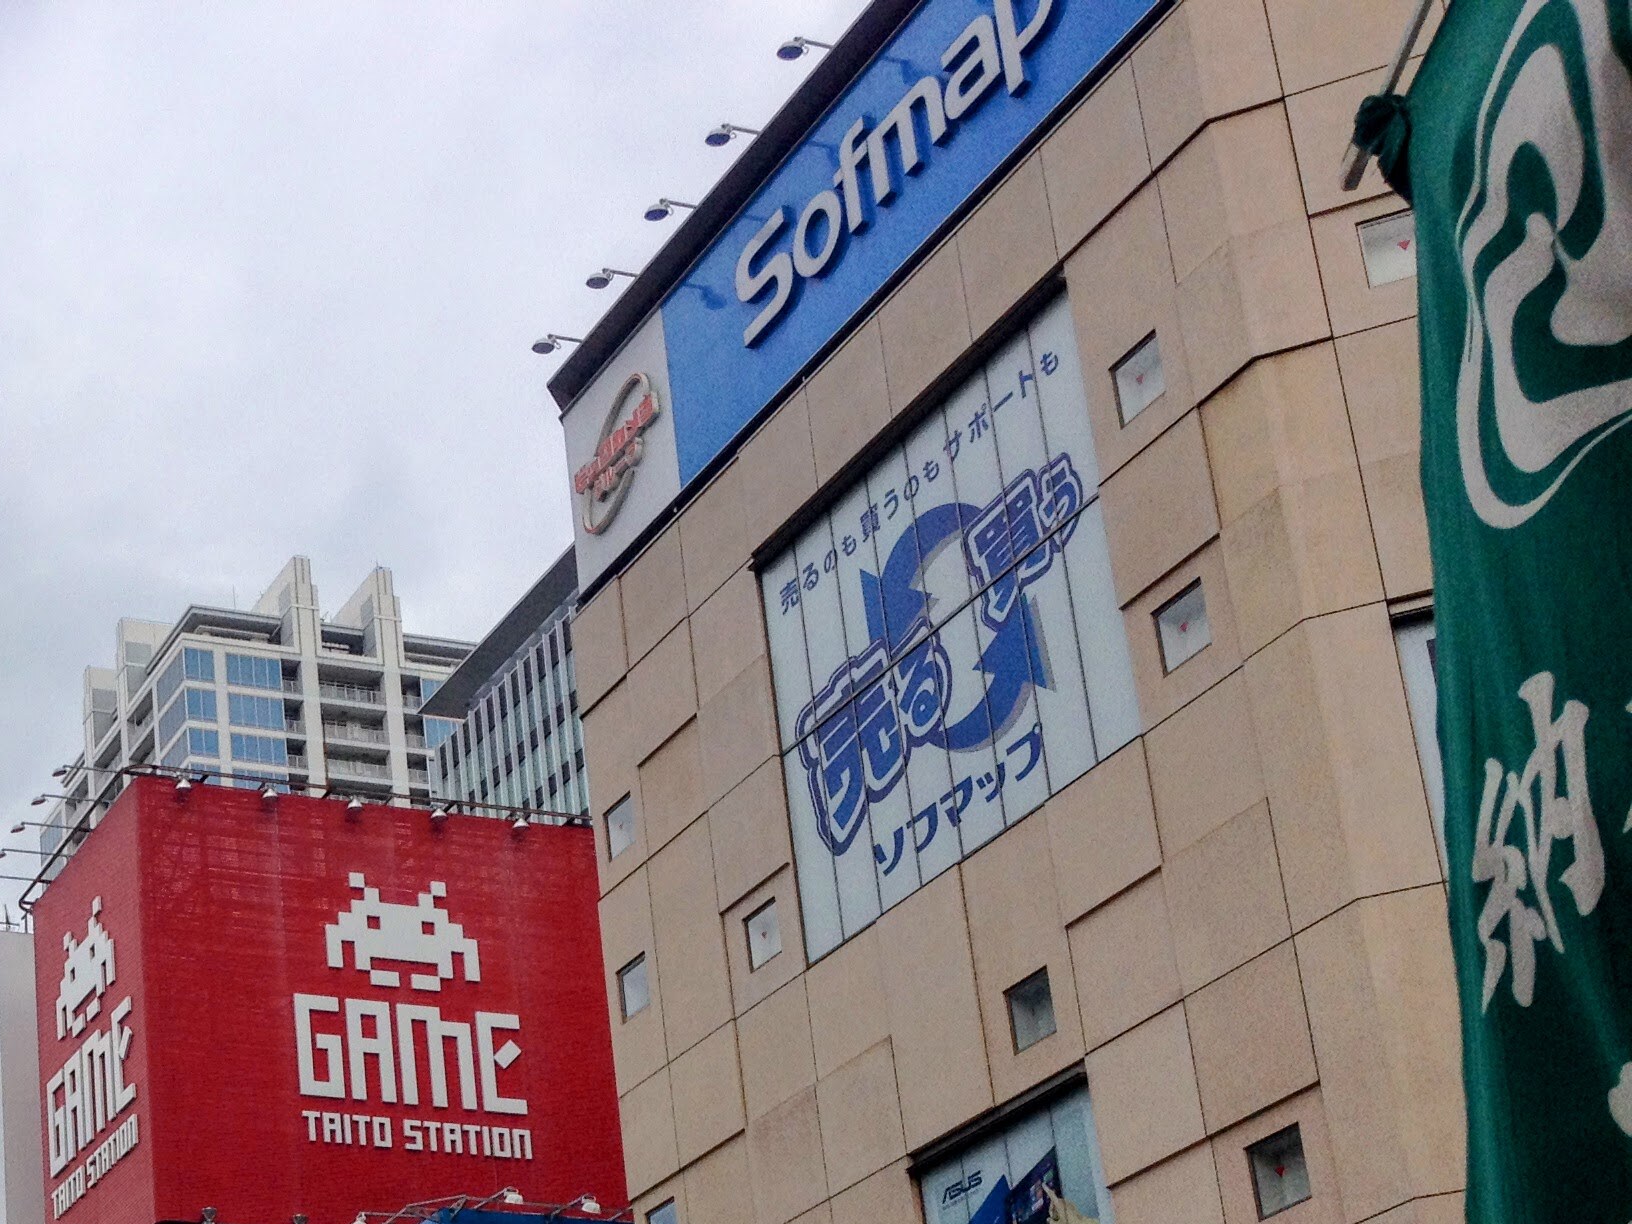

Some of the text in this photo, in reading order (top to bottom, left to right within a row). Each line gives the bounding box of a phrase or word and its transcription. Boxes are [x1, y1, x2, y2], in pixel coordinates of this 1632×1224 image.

[734, 0, 1058, 348] Sofmap
[873, 721, 1044, 877] ソフマップ
[45, 995, 137, 1179] GAME
[293, 993, 528, 1115] GAME
[51, 1114, 139, 1220] TAITO STATION
[301, 1110, 533, 1160] TAITO STATION
[942, 1170, 983, 1204] ASUS
